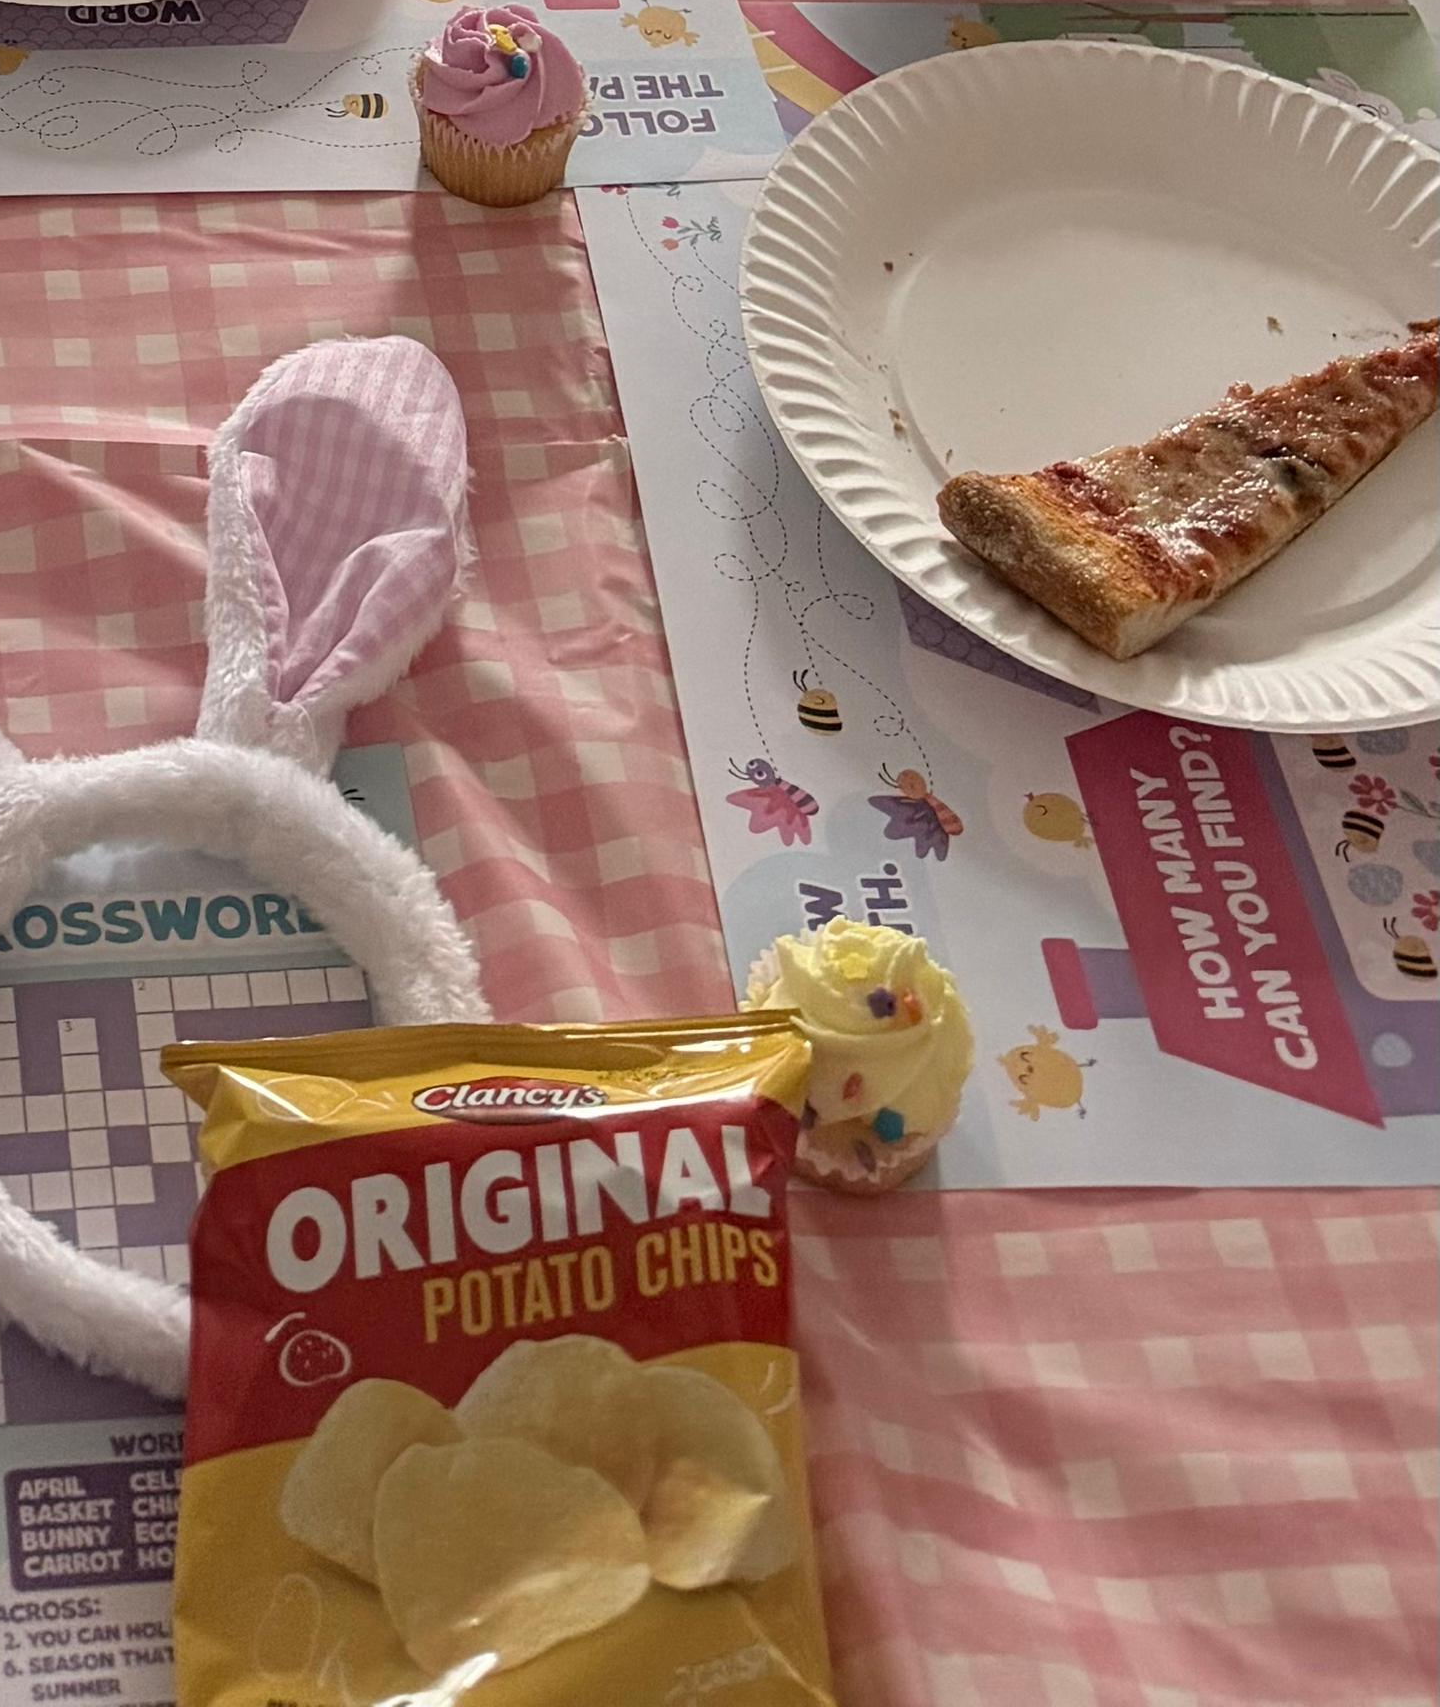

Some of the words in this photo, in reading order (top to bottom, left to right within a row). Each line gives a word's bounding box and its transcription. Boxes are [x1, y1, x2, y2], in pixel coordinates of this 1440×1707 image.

[67, 0, 201, 24] WORD
[633, 74, 724, 100] THE
[1168, 725, 1244, 848] FIND?
[1129, 766, 1202, 894] MANY
[1213, 859, 1279, 958] YOU
[1171, 906, 1245, 1021] HOW
[1252, 968, 1319, 1071] CAN
[413, 1081, 606, 1112] Clancy's
[265, 1124, 772, 1293] ORIGINAL
[422, 1247, 614, 1343] POTATO
[635, 1222, 778, 1297] CHIPS
[18, 1476, 87, 1501] APRIL
[19, 1499, 115, 1526] BASKET
[21, 1525, 111, 1551] BUNNY
[23, 1549, 125, 1578] CARROT
[28, 1629, 71, 1648] YOU
[76, 1625, 121, 1644] CAN
[126, 1619, 173, 1639] HOL
[29, 1652, 115, 1675] SEASON
[121, 1646, 175, 1665] THAT
[32, 1679, 121, 1702] SUMMER
